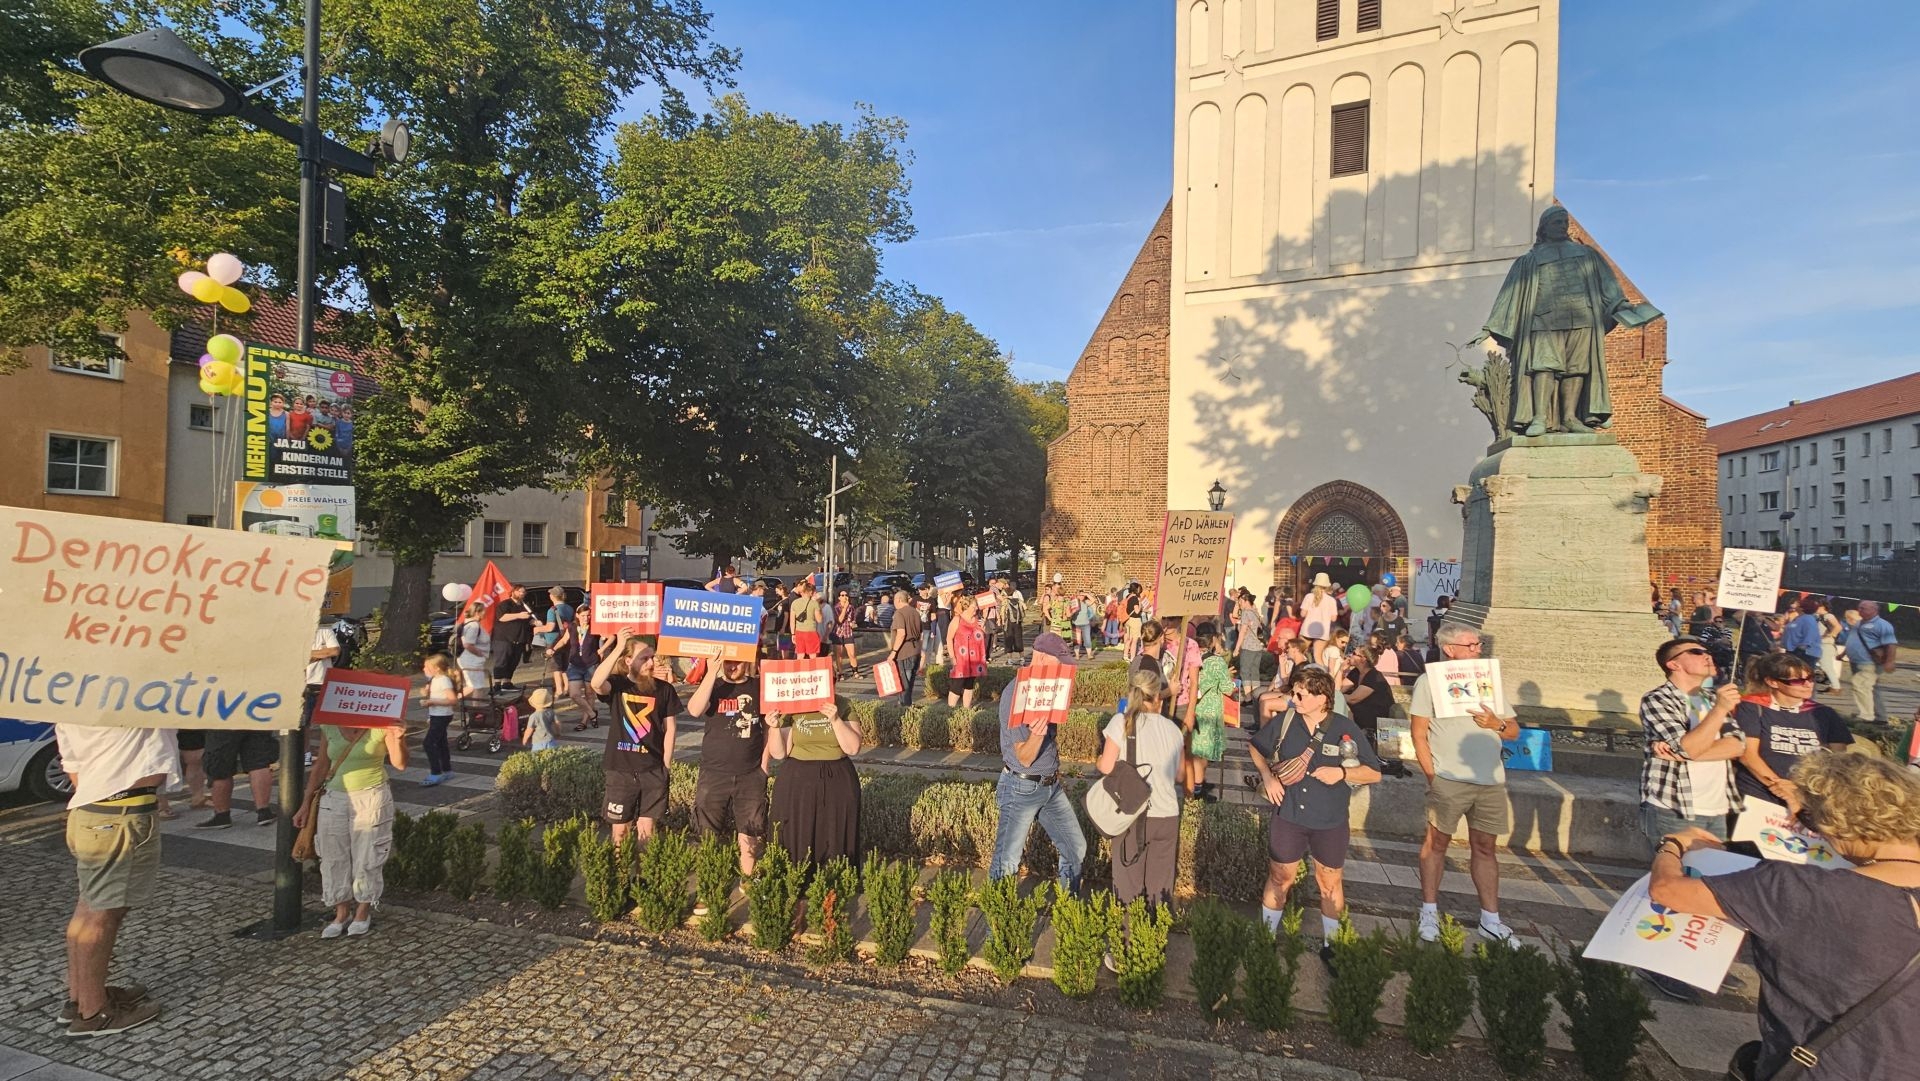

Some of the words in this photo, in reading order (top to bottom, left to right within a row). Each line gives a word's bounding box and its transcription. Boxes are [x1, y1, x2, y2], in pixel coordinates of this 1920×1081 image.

[248, 347, 352, 372] EINANDER
[247, 355, 267, 433] MUT
[274, 439, 289, 449] JA
[291, 440, 306, 449] ZU
[246, 435, 266, 477] MEHR
[282, 452, 329, 466] KINDERN
[330, 457, 343, 466] AN
[274, 464, 317, 476] ERSTER
[317, 467, 348, 479] STELLE
[1196, 514, 1229, 529] WÄHLEN
[1167, 535, 1186, 544] AUS
[11, 521, 325, 601] Demokratie
[1179, 549, 1195, 558] IST
[1198, 550, 1214, 559] WIE
[1164, 561, 1210, 576] KOTZEN
[43, 569, 219, 624] braucht
[1183, 589, 1219, 602] HUNGER
[600, 599, 630, 609] Gegen
[675, 599, 699, 611] WIR
[701, 602, 731, 615] SIND
[732, 606, 752, 617] DIE
[602, 611, 619, 619] und
[621, 610, 655, 619] Hetze!
[665, 615, 756, 634] BRANDMAUER!
[771, 676, 788, 685] Nie
[790, 674, 823, 684] wieder
[334, 686, 355, 697] Nie
[358, 689, 398, 701] wieder
[777, 688, 790, 697] ist
[792, 685, 819, 698] jetzt!
[338, 699, 354, 709] ist
[355, 701, 391, 713] jetzt!
